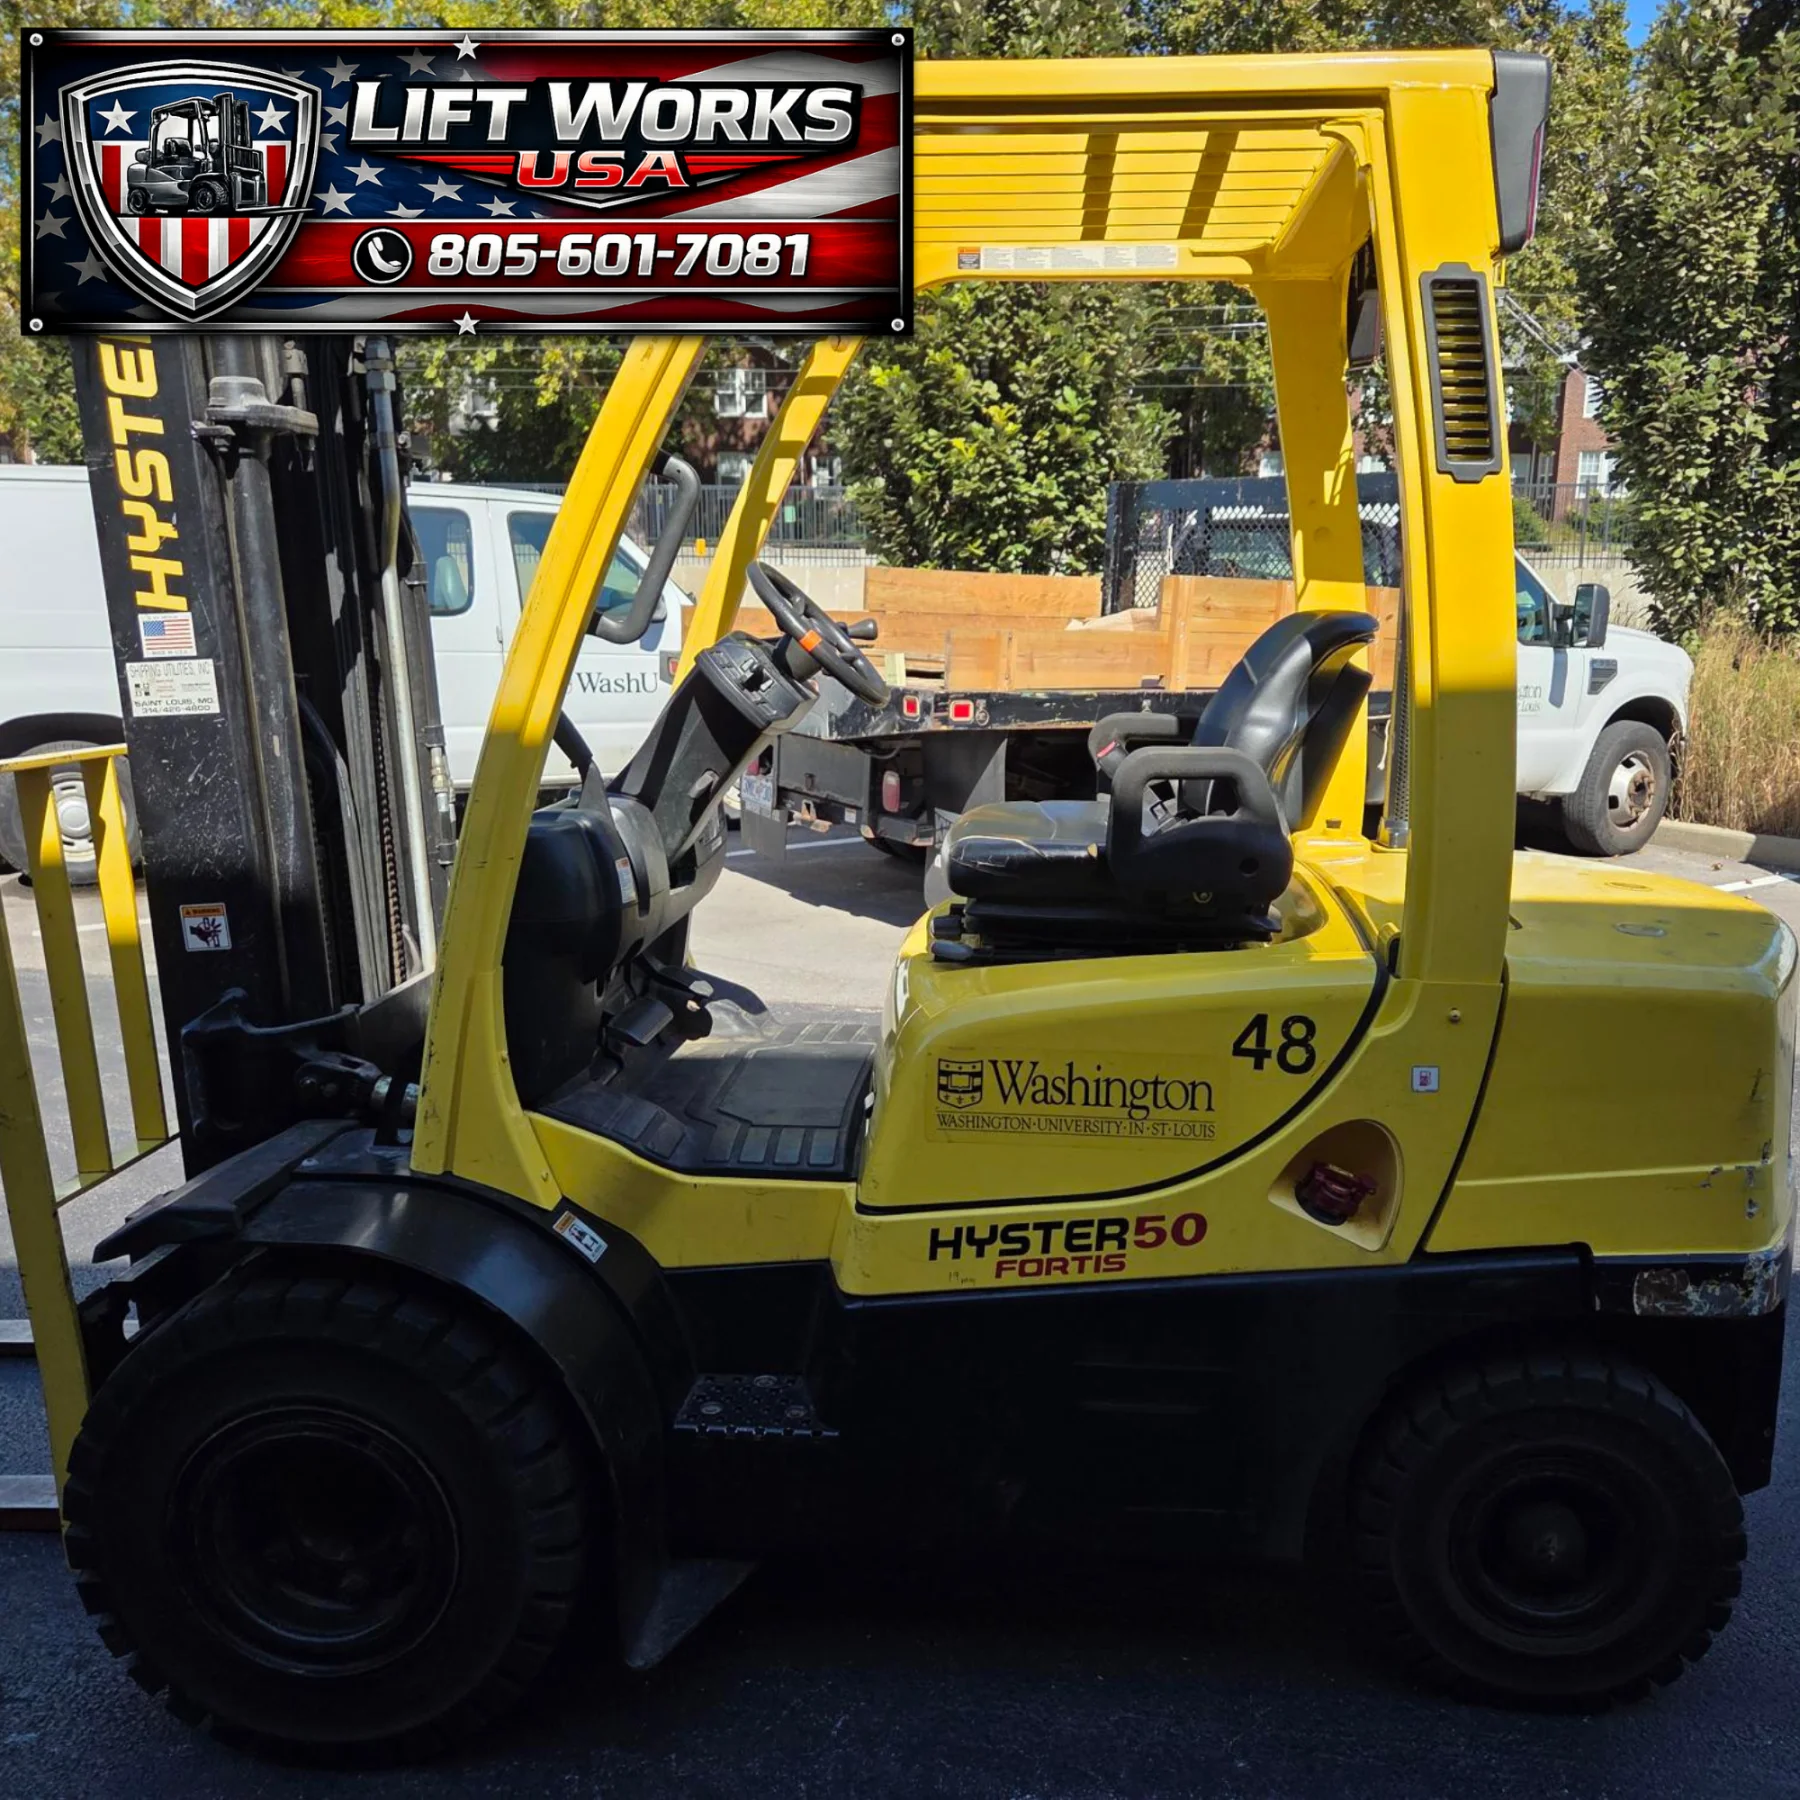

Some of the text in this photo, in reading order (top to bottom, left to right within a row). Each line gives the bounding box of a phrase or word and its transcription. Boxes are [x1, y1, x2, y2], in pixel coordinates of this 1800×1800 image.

[98, 335, 189, 611] HYSTE
[134, 700, 162, 708] SAINT
[576, 672, 658, 693] WashU
[1232, 1013, 1317, 1075] 48
[989, 1059, 1215, 1120] Washington
[928, 1212, 1208, 1262] HYSTER 50
[994, 1253, 1127, 1279] FORTIS
